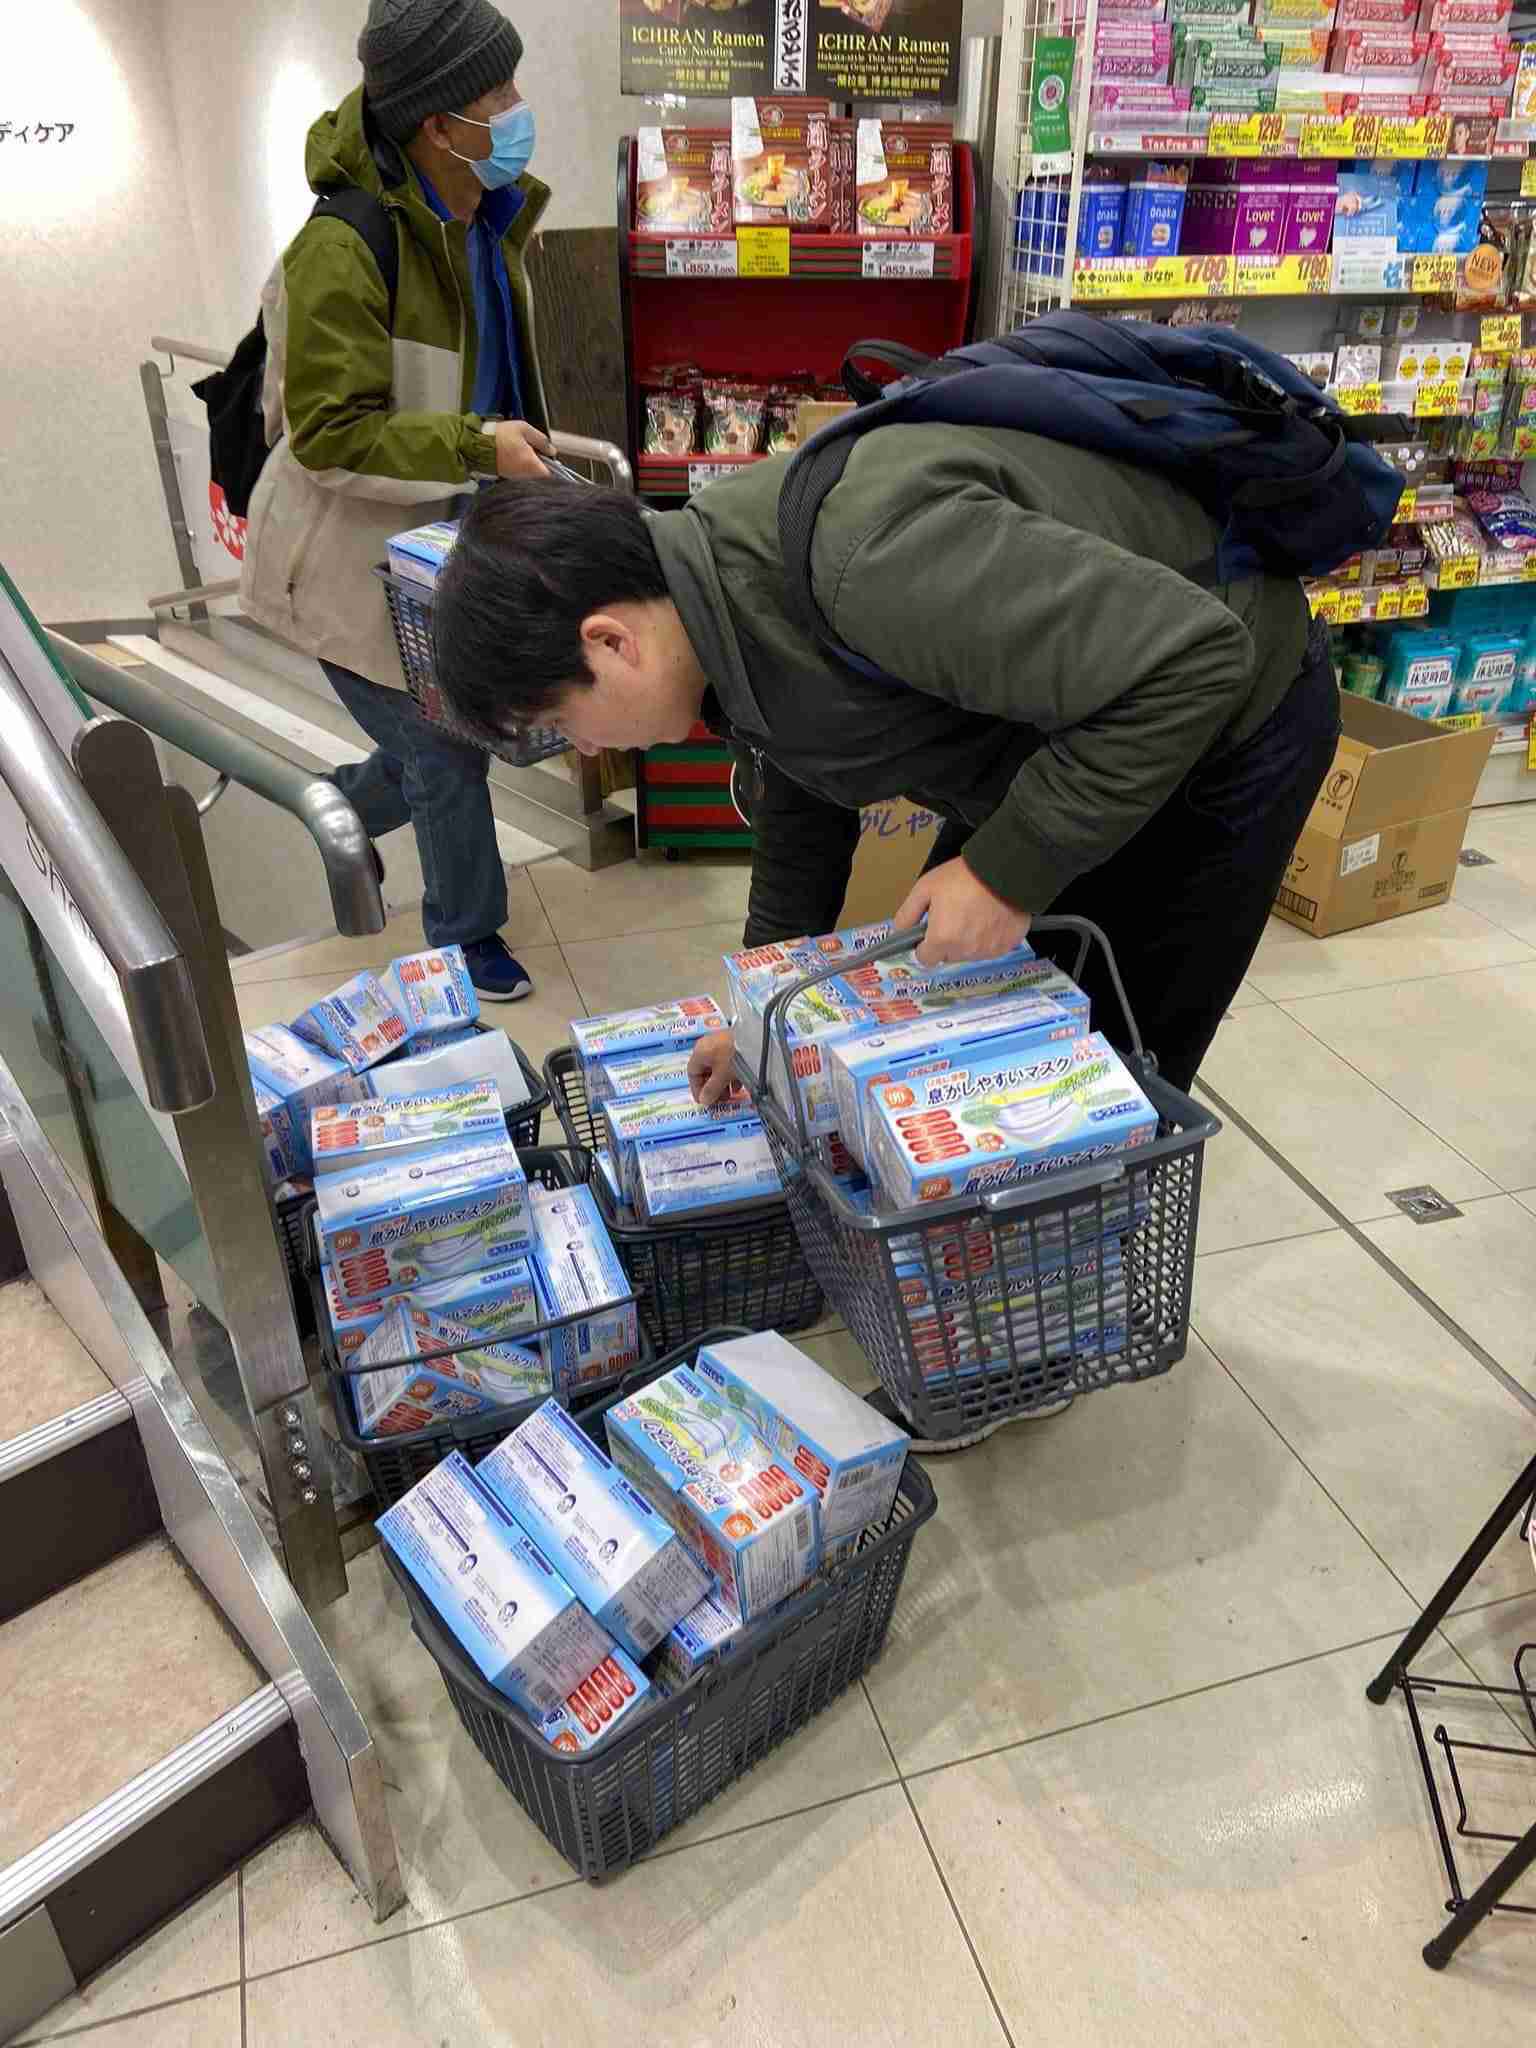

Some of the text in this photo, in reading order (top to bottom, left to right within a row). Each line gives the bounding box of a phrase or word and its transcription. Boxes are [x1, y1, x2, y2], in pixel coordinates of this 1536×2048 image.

[632, 26, 765, 47] ICHIRAN Ramen
[818, 33, 950, 53] ICHIRAN Ramen
[659, 45, 734, 58] Curly Noodles
[1149, 205, 1177, 219] onaka
[1246, 208, 1275, 223] Lovet
[1296, 208, 1325, 223] Lovet
[1470, 249, 1499, 271] NEW
[1097, 271, 1134, 283] onaka
[1184, 257, 1228, 283] 1780
[1246, 269, 1276, 281] Lovet
[1410, 671, 1449, 686] 休足時間
[927, 1056, 1072, 1105] 息がしやすいマスク
